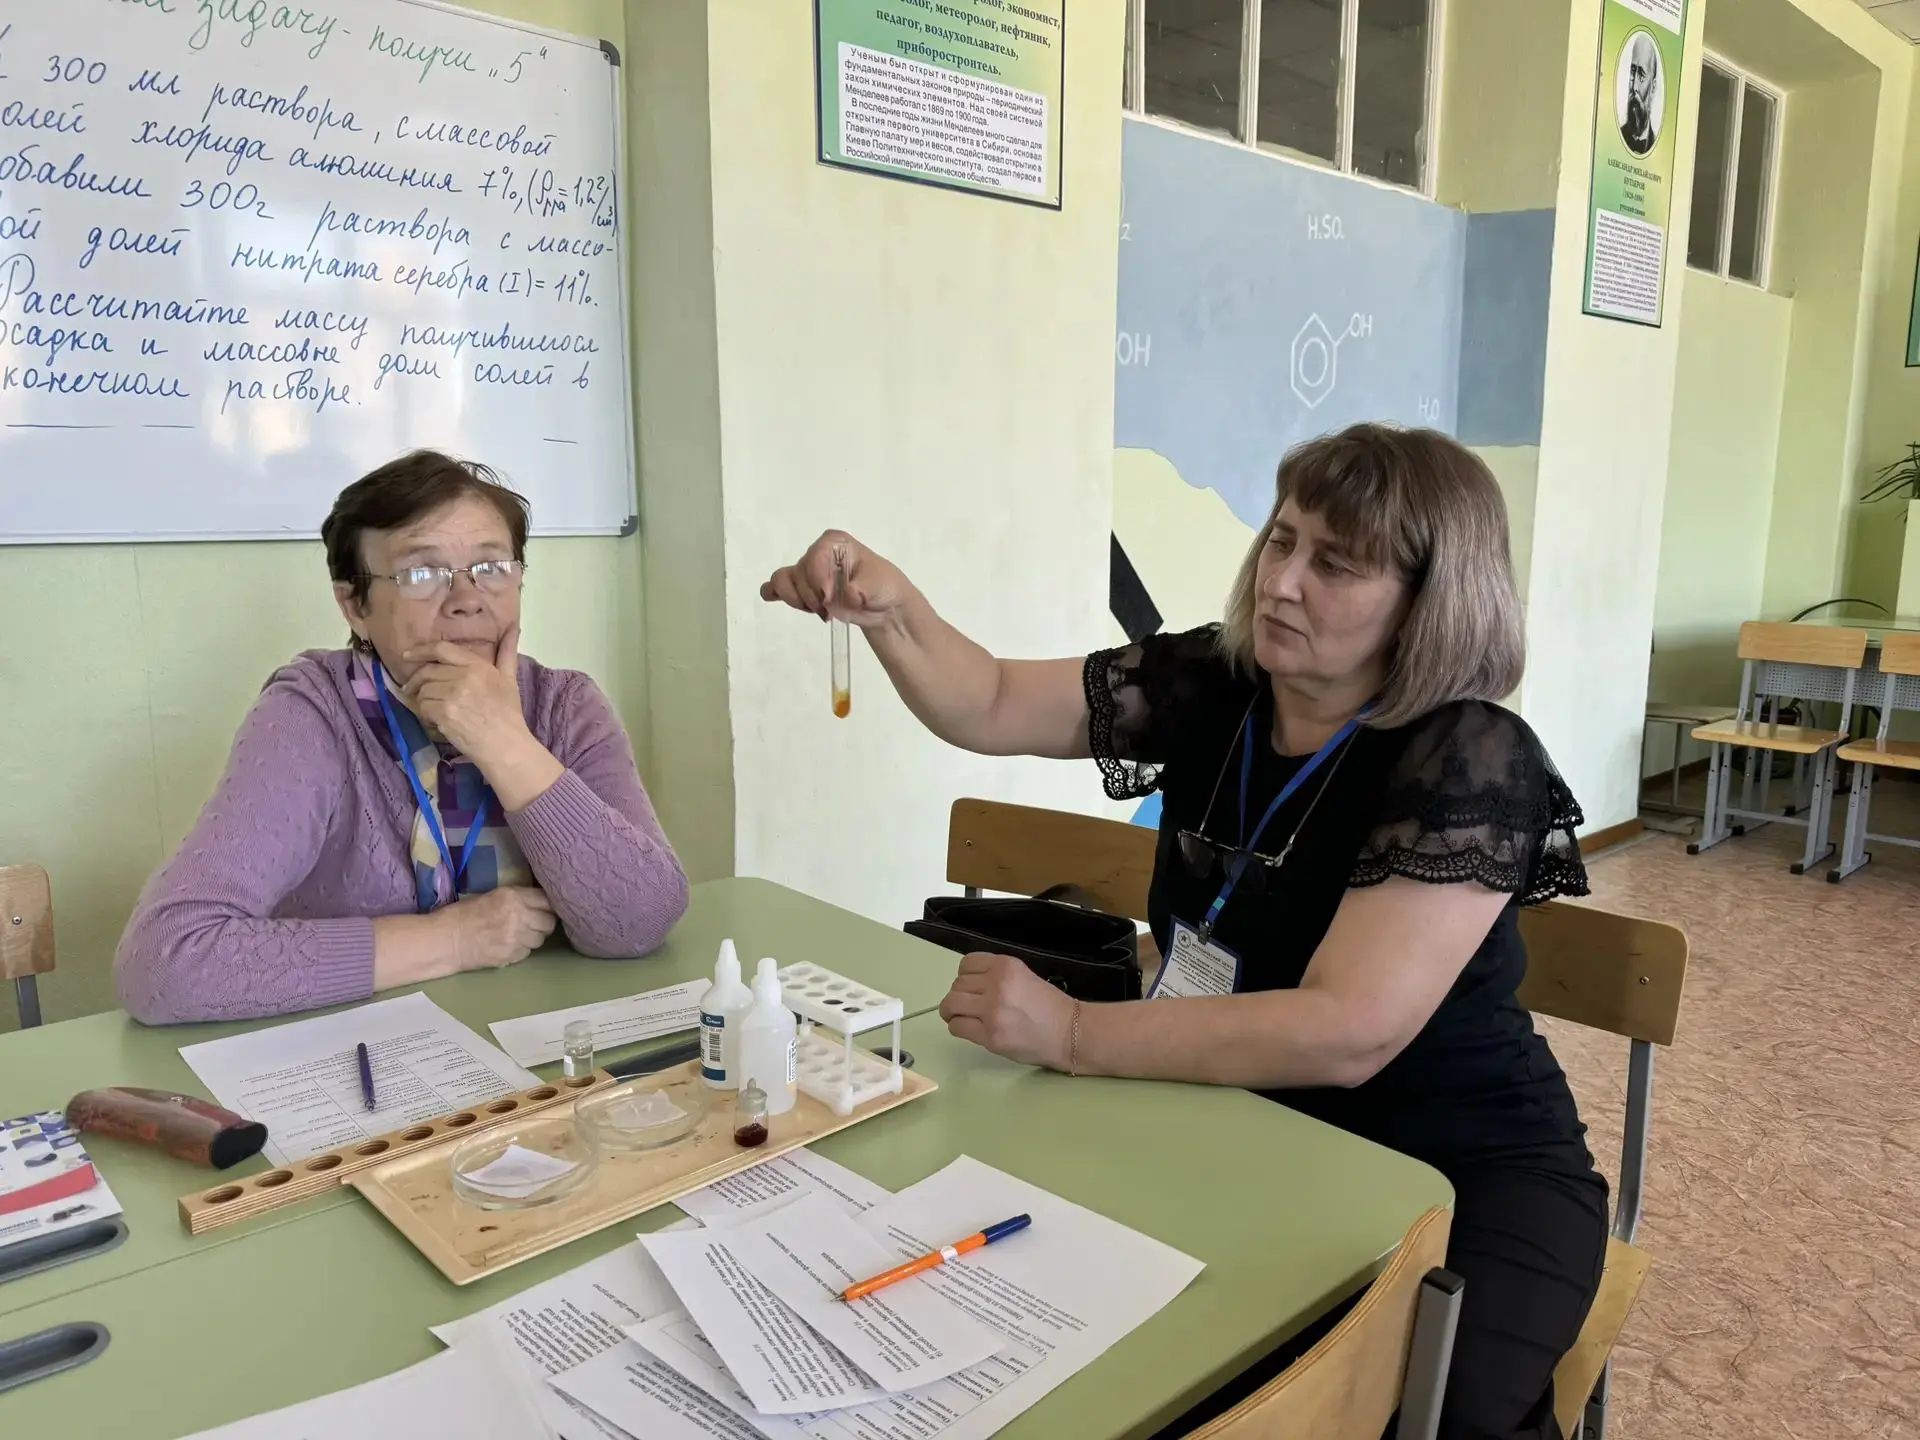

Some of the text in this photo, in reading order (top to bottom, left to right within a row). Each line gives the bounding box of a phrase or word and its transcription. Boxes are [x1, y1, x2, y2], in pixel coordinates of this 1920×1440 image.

[876, 9, 1019, 61] педагог, воздухоплаватель,
[935, 3, 999, 32] метеоролог,
[1001, 23, 1051, 48] нефтяник,
[1007, 3, 1061, 30] экономист,
[44, 55, 107, 84] 300
[129, 69, 180, 94] мл
[369, 25, 475, 83] получи
[851, 48, 886, 64] Ученым
[889, 58, 907, 70] был
[909, 64, 939, 78] открыт
[948, 74, 1013, 97] сформулирован
[1015, 92, 1033, 103] один
[845, 60, 1043, 116] фундаментальных законов природы периодический
[845, 73, 869, 84] закон
[872, 80, 920, 98] химических
[970, 102, 984, 114] Над
[987, 108, 1008, 118] своей
[1010, 114, 1042, 128] системой
[846, 84, 889, 102] Менделеев
[891, 96, 920, 110] работал
[928, 104, 944, 116] 1869
[945, 110, 953, 118] по
[956, 110, 971, 121] 1900
[845, 110, 885, 126] открытия
[888, 120, 919, 133] первого
[921, 128, 974, 146] университета
[1014, 149, 1042, 161] основал
[846, 121, 880, 137] Главную
[882, 131, 908, 144] палату
[910, 137, 924, 148] мер
[956, 147, 1004, 164] содействовал
[1006, 158, 1036, 171] открытию
[852, 98, 857, 107] В
[859, 102, 900, 117] последние
[902, 112, 920, 122] годы
[921, 116, 943, 126] жизни
[945, 119, 984, 136] Менделеев
[986, 131, 1005, 141] много
[1006, 136, 1029, 147] сделал
[131, 120, 274, 176] хлорида
[289, 147, 463, 193] алюминия
[846, 134, 870, 147] Киеве
[873, 140, 943, 163] Политехнического
[846, 146, 890, 164] Российской
[892, 158, 923, 170] империи
[924, 162, 966, 179] Химическое
[306, 201, 472, 256] раствора
[501, 231, 512, 249] с
[79, 226, 191, 269] долей
[231, 242, 383, 284] нитрата
[394, 259, 489, 300] серебра
[0, 253, 249, 324] Рассчитайте
[275, 307, 368, 350] массу
[142, 339, 168, 355] и
[374, 353, 441, 390] доли
[475, 363, 554, 385] солей
[572, 361, 590, 389] в
